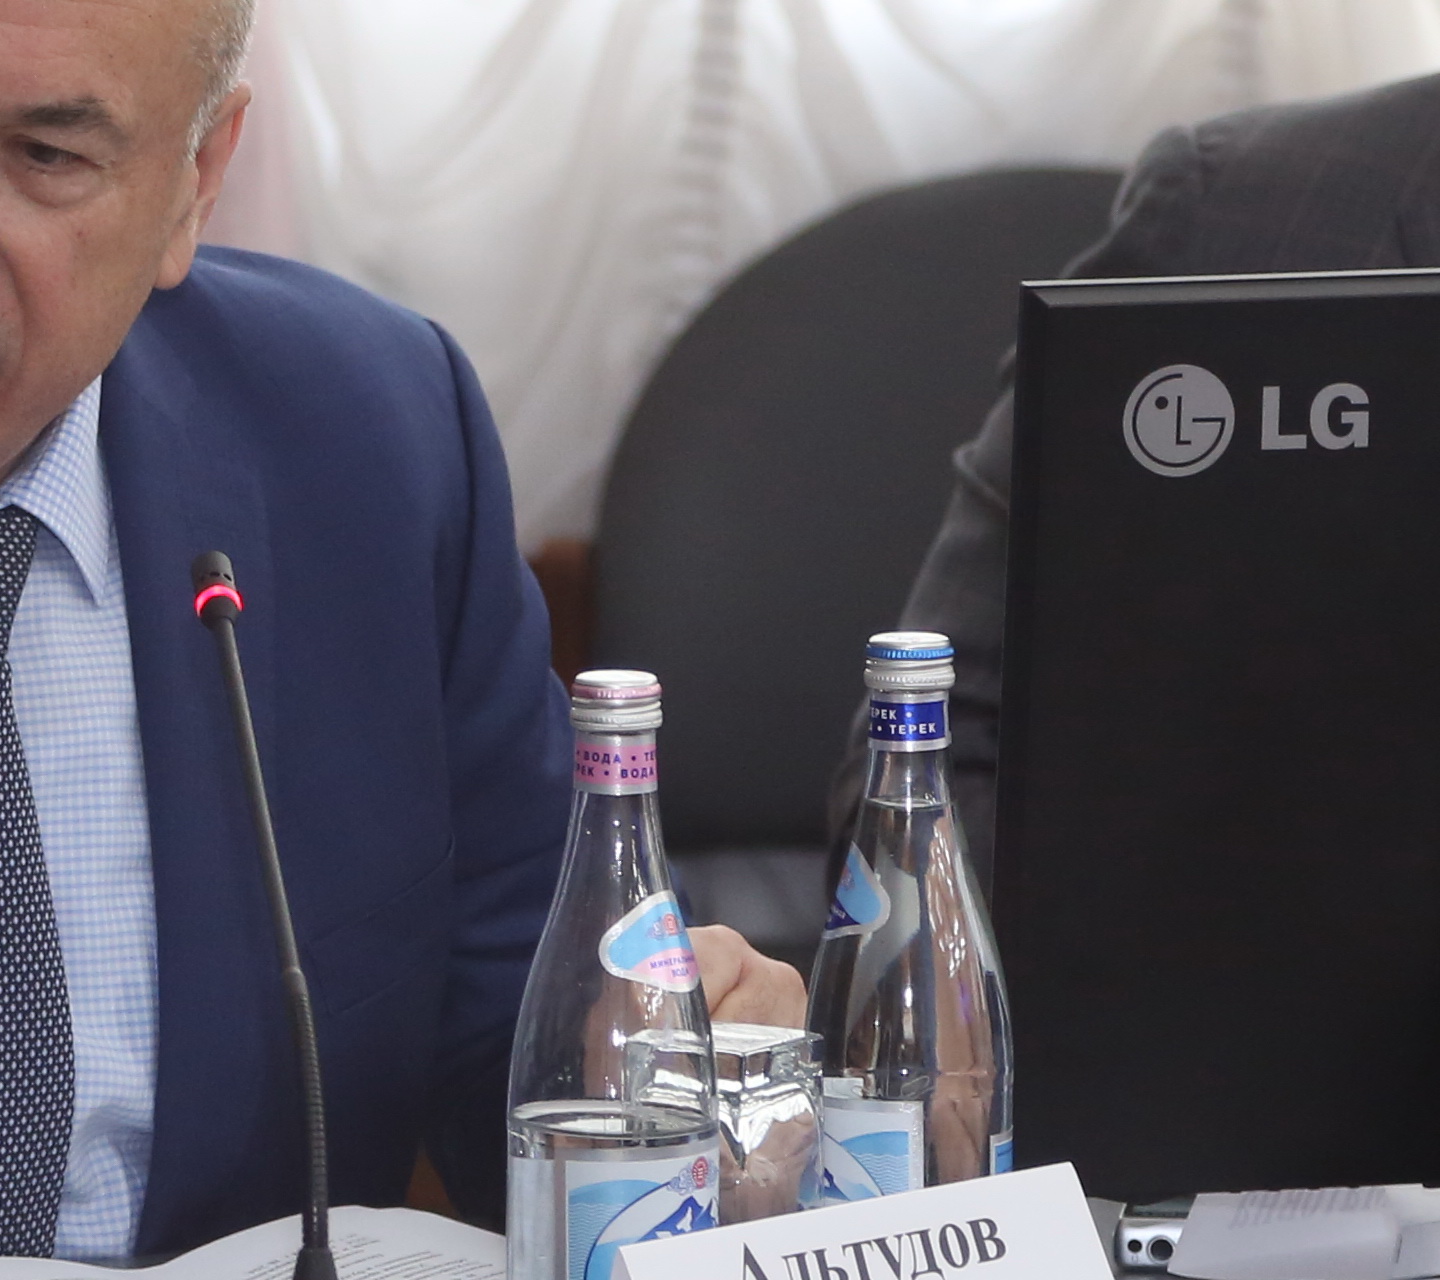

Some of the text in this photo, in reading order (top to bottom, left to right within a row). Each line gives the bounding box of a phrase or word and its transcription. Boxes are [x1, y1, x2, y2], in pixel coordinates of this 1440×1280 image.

[1261, 383, 1370, 450] LG
[889, 723, 936, 734] ТЕРЕК
[583, 750, 622, 764] ВОДА
[621, 767, 654, 779] ВОДА
